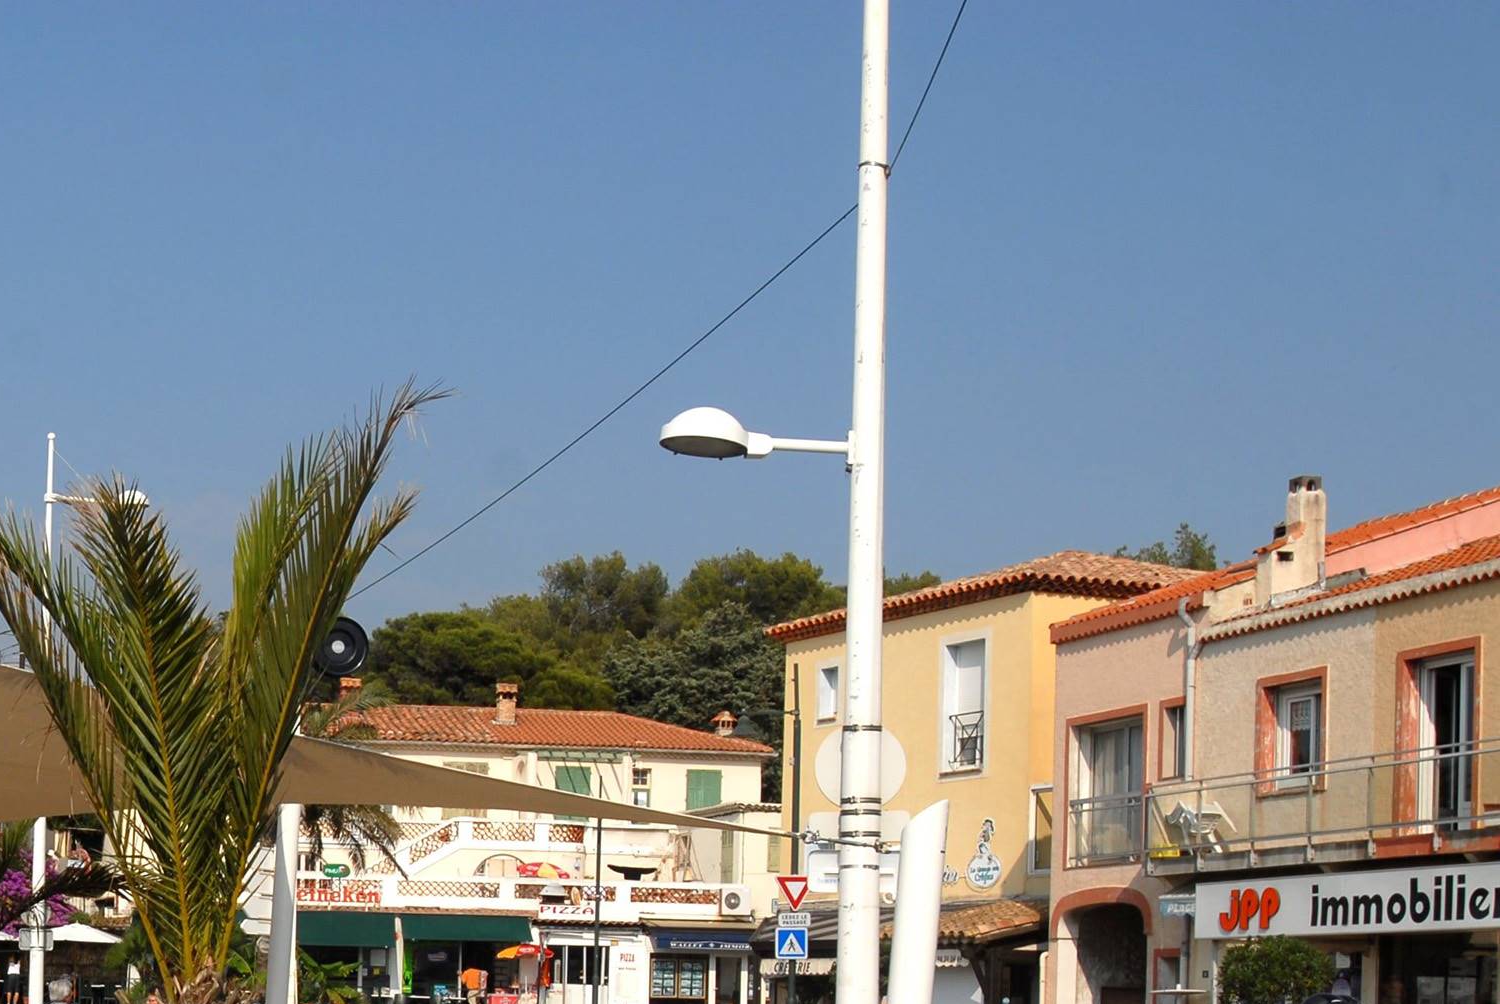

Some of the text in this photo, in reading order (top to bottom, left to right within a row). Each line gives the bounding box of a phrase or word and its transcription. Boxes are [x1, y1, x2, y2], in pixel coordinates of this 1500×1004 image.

[296, 886, 381, 903] eineken
[540, 905, 595, 915] PIZZA
[1219, 887, 1281, 932] JPP
